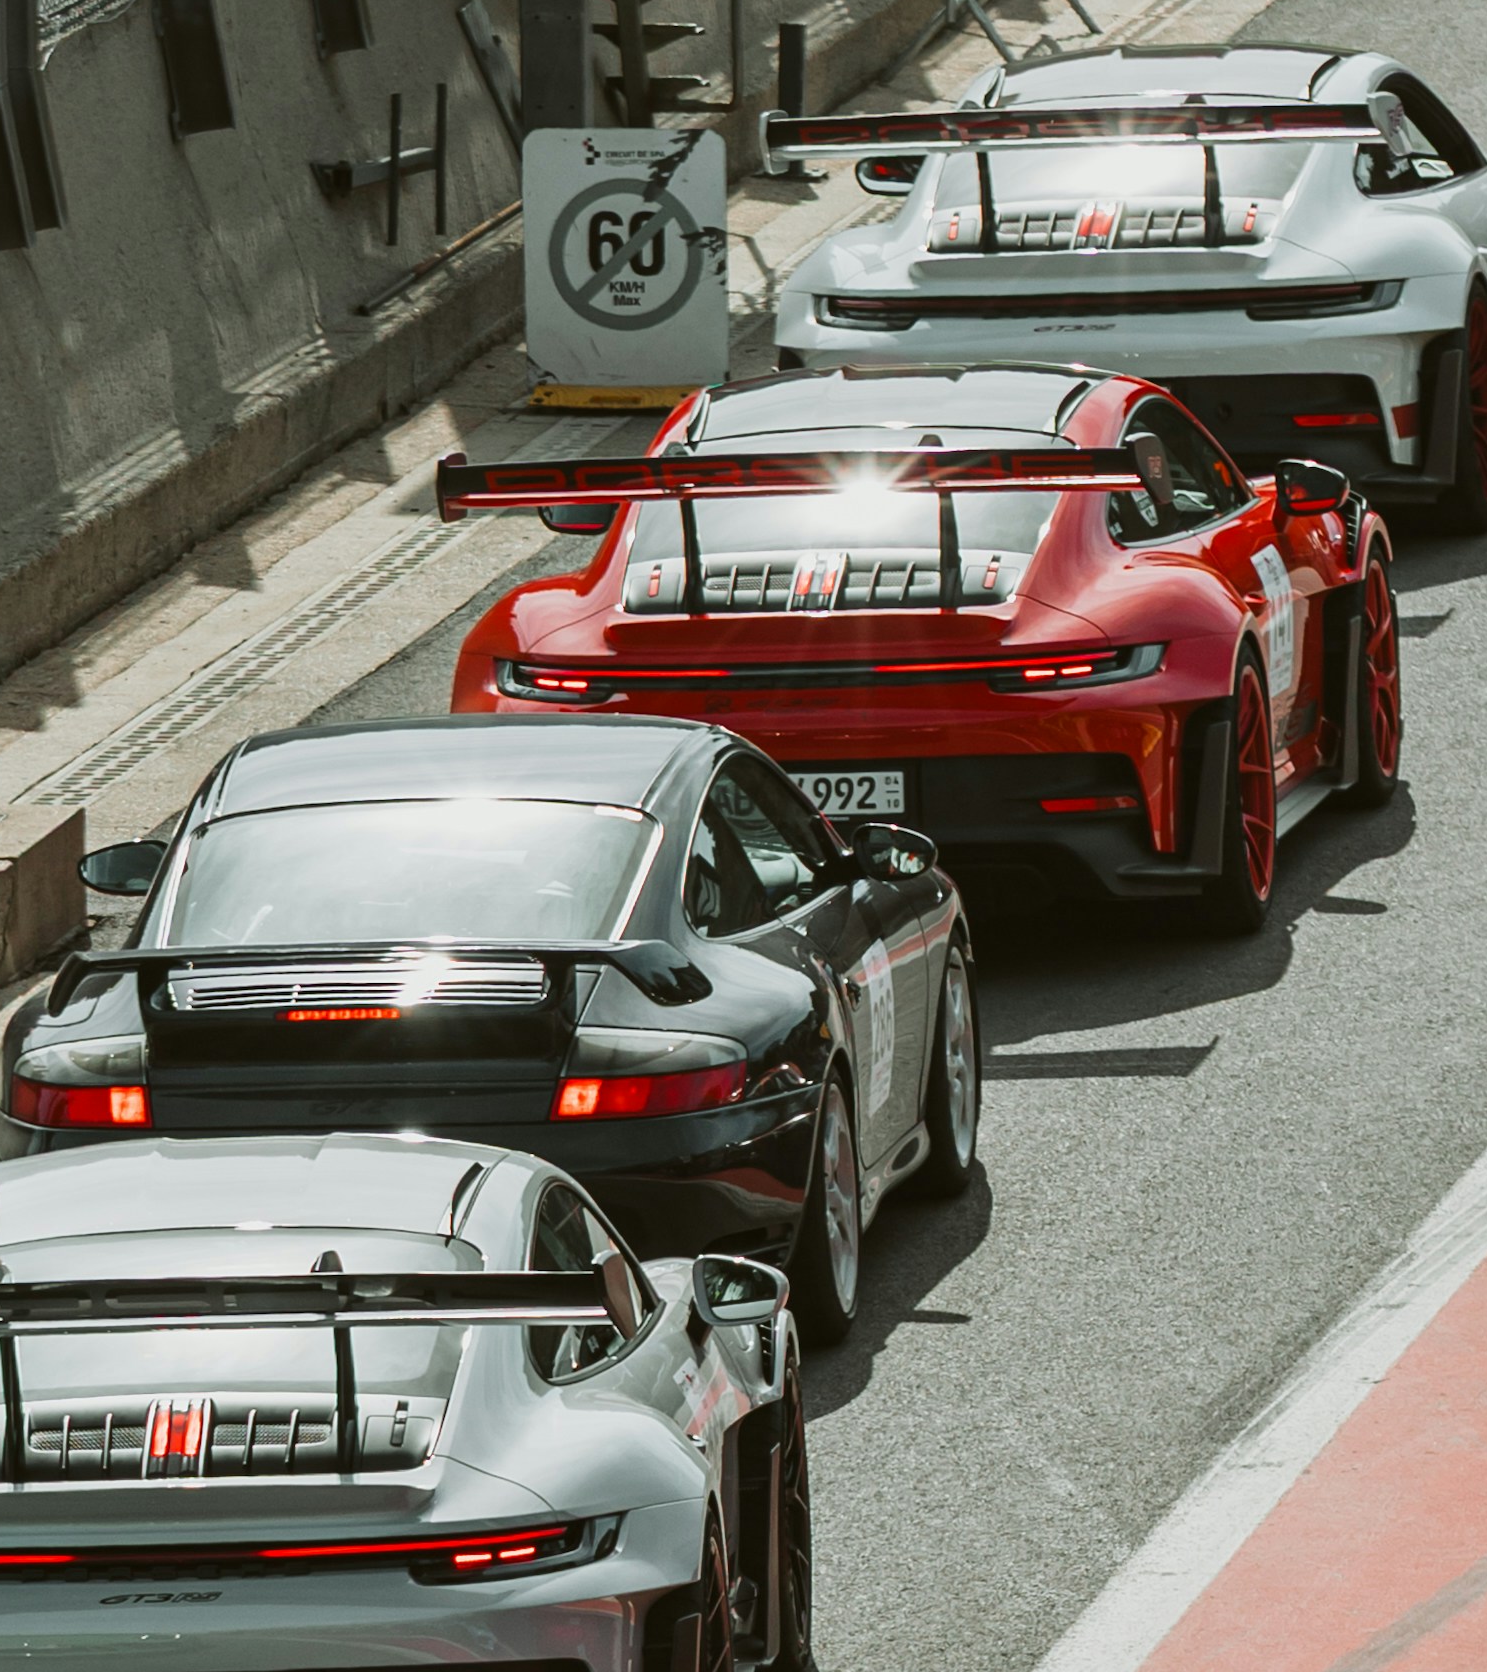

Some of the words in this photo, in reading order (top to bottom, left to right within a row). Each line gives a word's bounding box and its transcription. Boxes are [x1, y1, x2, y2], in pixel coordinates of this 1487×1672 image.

[588, 211, 665, 276] 60
[613, 295, 641, 306] Max
[814, 776, 876, 811] 992
[887, 798, 900, 808] 10
